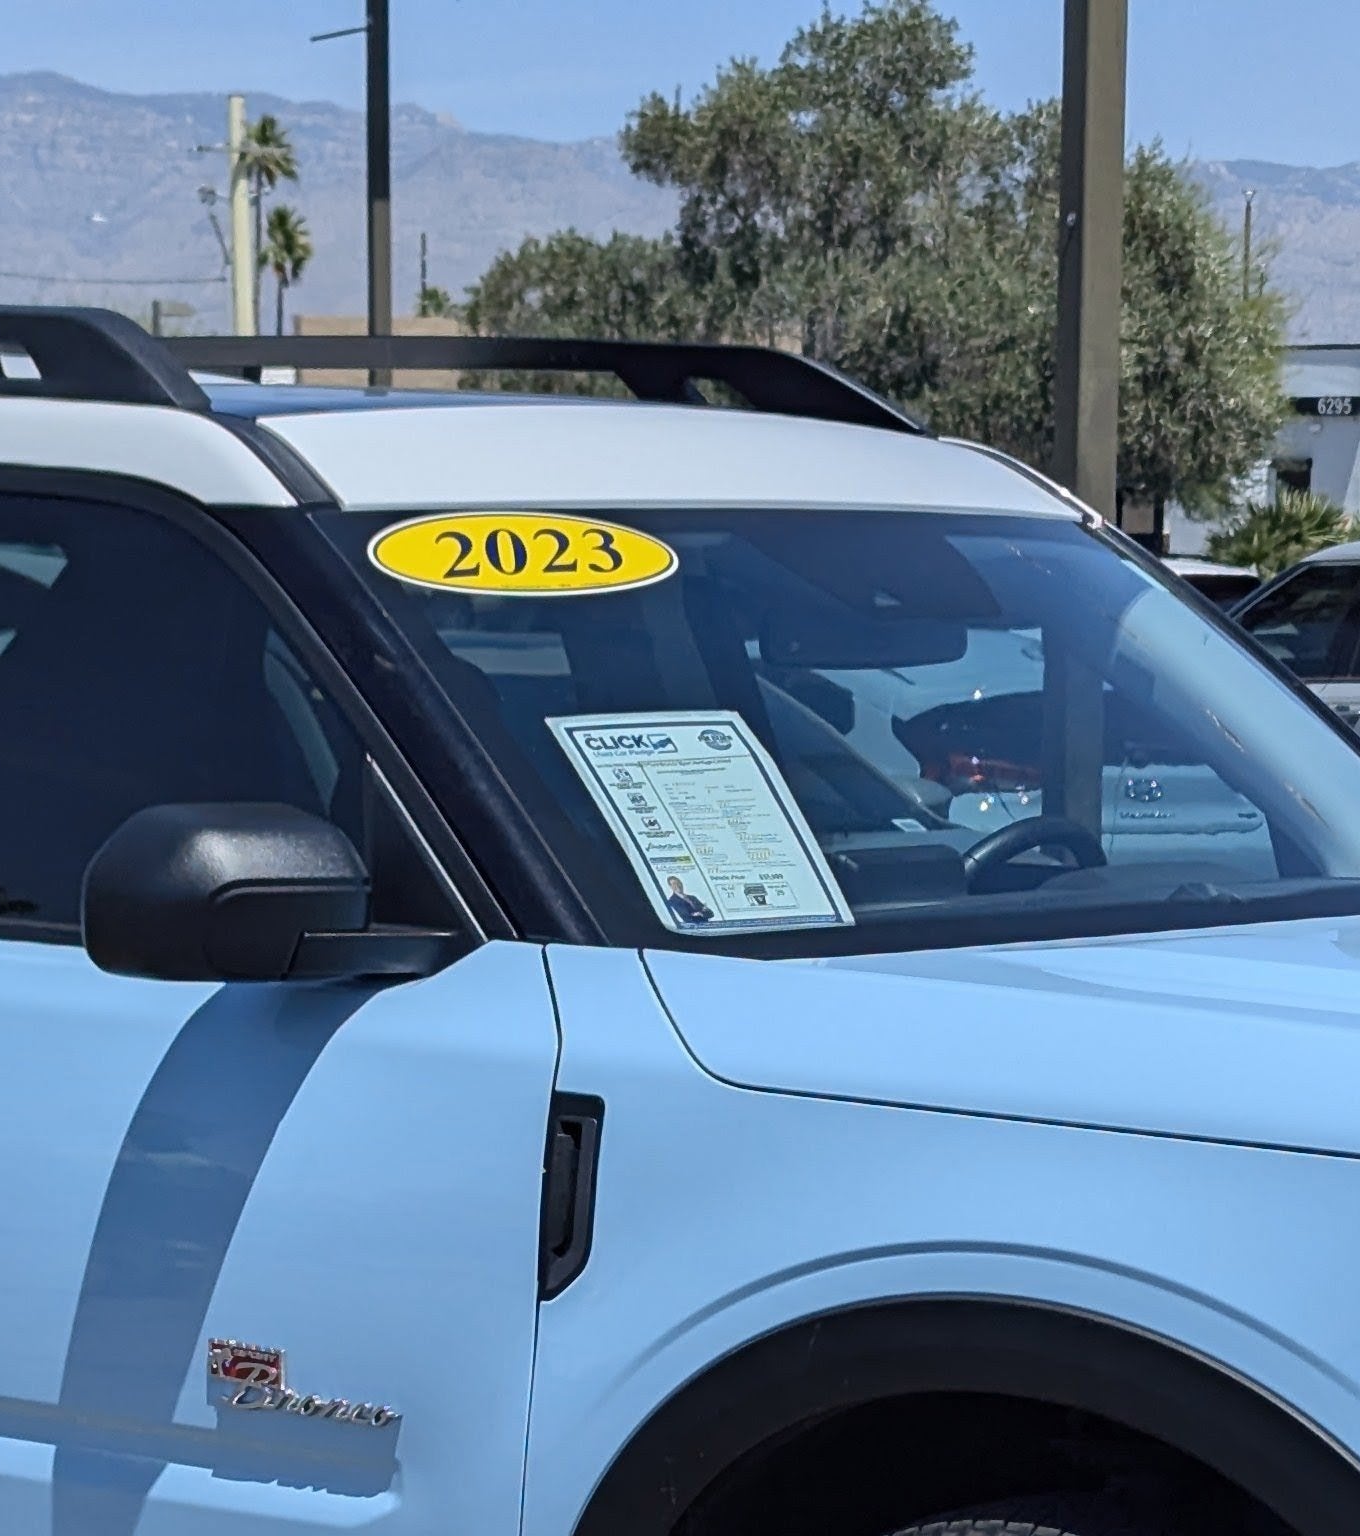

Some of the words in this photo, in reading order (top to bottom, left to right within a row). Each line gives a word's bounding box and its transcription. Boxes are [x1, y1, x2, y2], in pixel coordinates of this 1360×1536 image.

[1317, 397, 1353, 415] 6295
[433, 526, 625, 579] 2023
[584, 733, 650, 750] CLICK
[218, 1360, 404, 1429] Bronco
